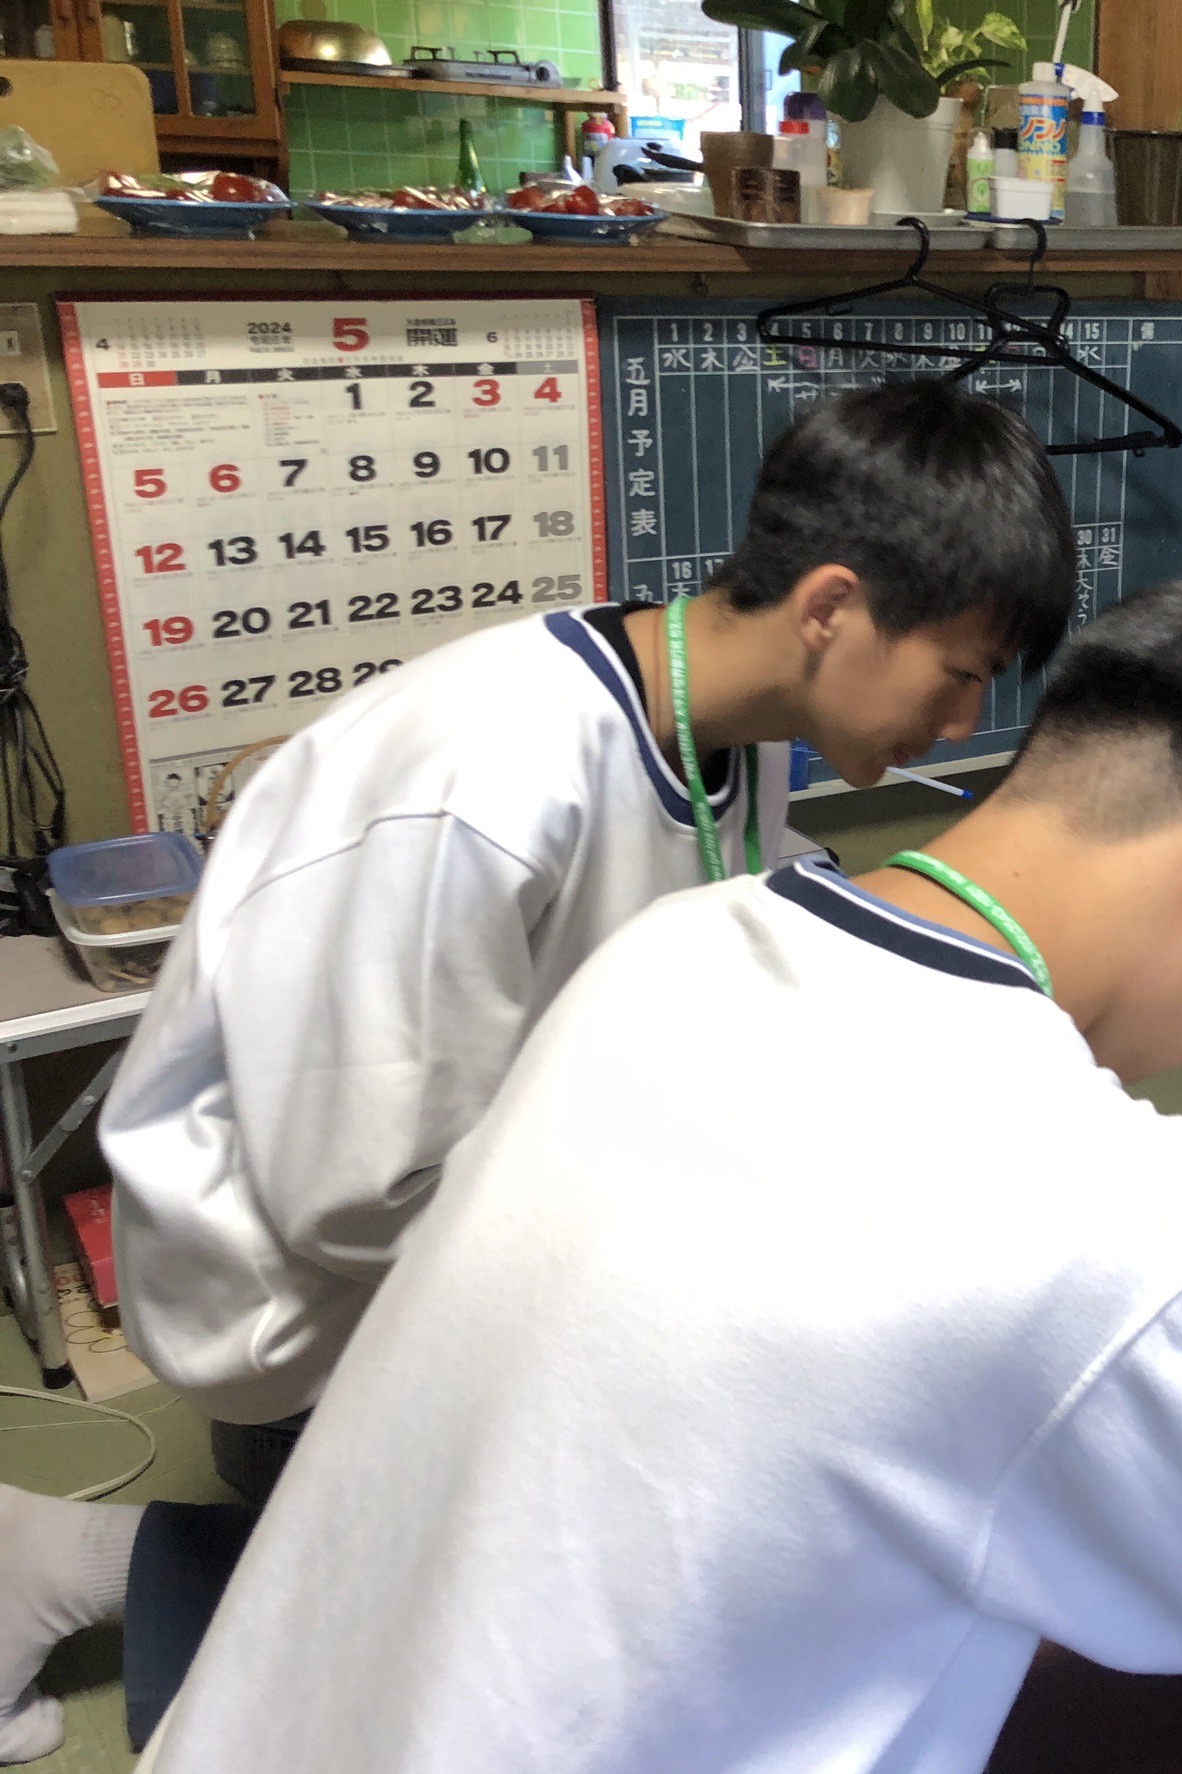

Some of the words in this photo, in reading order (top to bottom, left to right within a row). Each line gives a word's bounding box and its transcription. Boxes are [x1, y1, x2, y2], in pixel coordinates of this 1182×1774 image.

[247, 321, 293, 335] 2024
[331, 316, 370, 352] 5
[486, 331, 498, 344] 6
[669, 322, 680, 343] 1
[703, 322, 714, 342] 2
[736, 322, 748, 342] 3
[801, 321, 812, 339] 5
[832, 321, 844, 341] 6
[863, 321, 874, 341] 7
[893, 321, 904, 341] 8
[923, 321, 934, 341] 9
[948, 321, 966, 341] 10
[978, 322, 993, 341] 11
[1084, 322, 1101, 341] 15
[95, 337, 110, 351] 4
[662, 348, 693, 369] 水
[700, 348, 725, 372] 木
[731, 344, 760, 372] 金
[762, 345, 788, 366] 土
[799, 344, 818, 369] 日
[825, 346, 844, 369] 月
[128, 372, 145, 387] 日
[203, 370, 222, 385] 月
[276, 367, 296, 382] 火
[344, 365, 364, 379] 水
[411, 363, 430, 377] 木
[476, 361, 495, 376] 金
[345, 382, 362, 410] 1
[409, 380, 436, 408] 2
[472, 378, 501, 407] 3
[534, 377, 562, 403] 4
[134, 468, 167, 499] 5
[209, 463, 241, 493] 6
[279, 458, 307, 487] 7
[349, 455, 376, 482] 8
[413, 451, 440, 479] 9
[467, 447, 510, 475] 10
[532, 444, 569, 472] 11
[136, 542, 186, 574] 12
[208, 536, 258, 567] 13
[278, 530, 326, 559] 14
[345, 524, 390, 553] 15
[410, 519, 453, 548] 16
[472, 514, 512, 542] 17
[533, 510, 575, 538] 18
[1101, 527, 1117, 543] 31
[671, 561, 693, 580] 16
[143, 616, 194, 647] 19
[212, 607, 271, 639] 20
[288, 599, 331, 630] 21
[348, 592, 400, 623] 22
[410, 585, 463, 615] 23
[472, 580, 524, 609] 24
[531, 574, 582, 604] 25
[148, 686, 210, 719] 26
[221, 674, 276, 708] 27
[288, 667, 342, 699] 28
